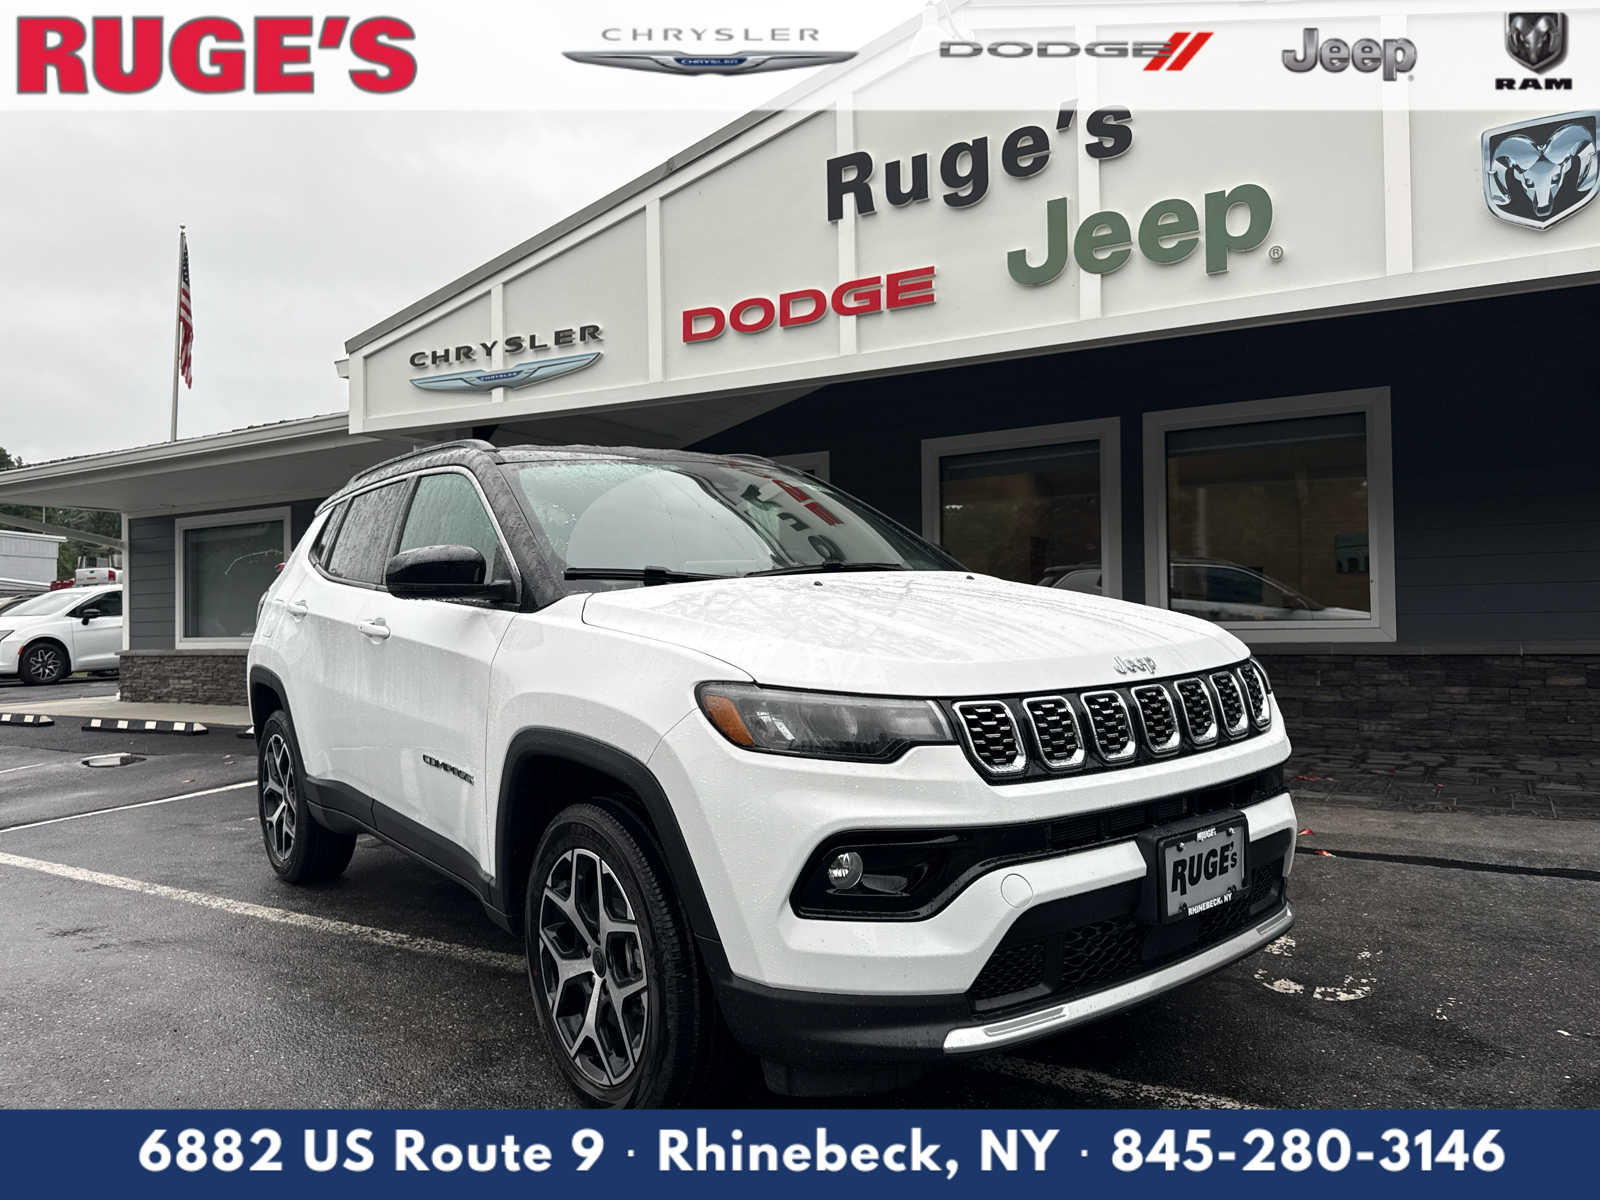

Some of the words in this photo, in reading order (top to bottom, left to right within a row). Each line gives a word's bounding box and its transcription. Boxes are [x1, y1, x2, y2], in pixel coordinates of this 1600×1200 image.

[826, 99, 1134, 222] Ruge's
[1007, 183, 1274, 288] Jeep
[682, 265, 936, 343] DODGE
[409, 324, 604, 367] CHRYSLER
[1113, 655, 1157, 675] Jeep
[1223, 893, 1233, 903] NY
